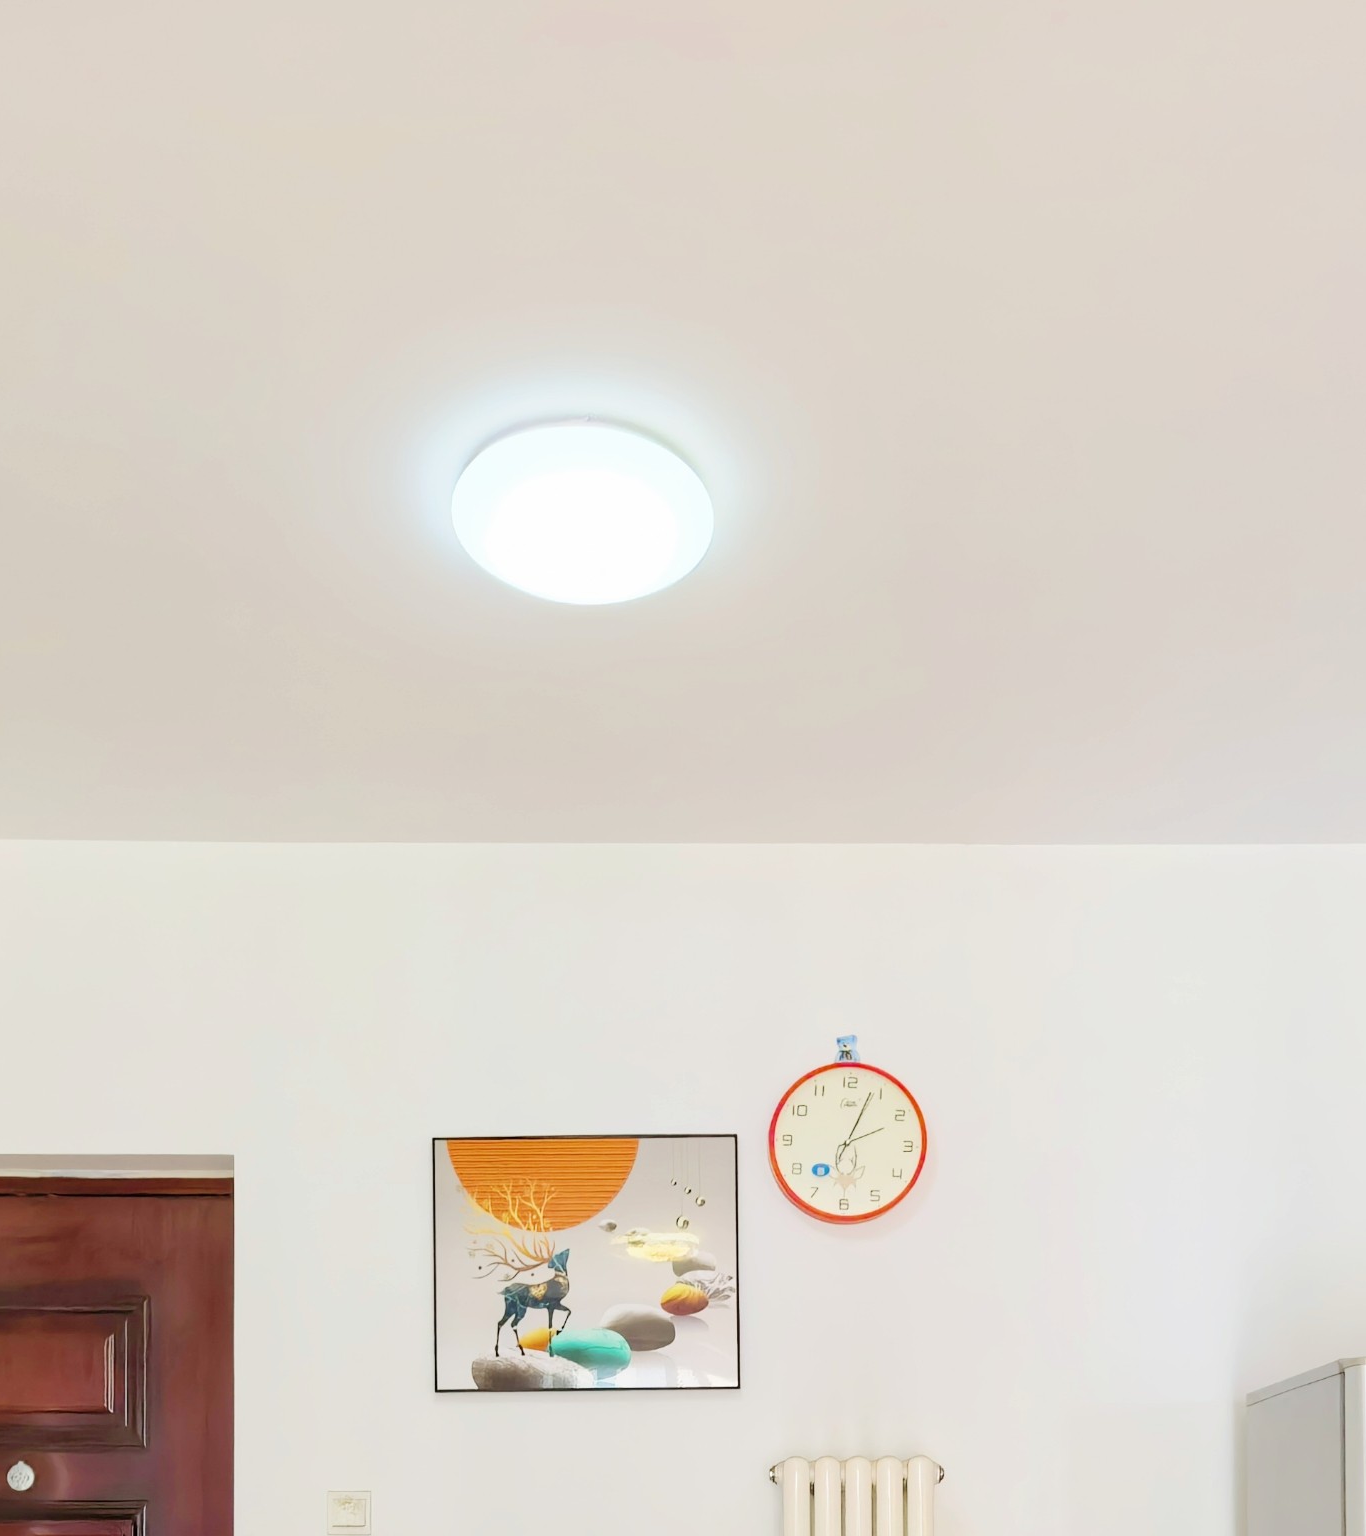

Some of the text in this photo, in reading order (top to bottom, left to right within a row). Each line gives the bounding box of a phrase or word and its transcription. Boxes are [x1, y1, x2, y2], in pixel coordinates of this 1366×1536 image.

[842, 1077, 858, 1088] 12
[814, 1085, 825, 1096] 11
[792, 1105, 807, 1116] 10
[895, 1110, 905, 1121] 2
[782, 1135, 792, 1146] 9
[903, 1141, 913, 1152] 3
[792, 1163, 802, 1175] 8
[892, 1169, 902, 1179] 4
[810, 1187, 819, 1198] 7
[870, 1190, 880, 1202] 5
[839, 1199, 849, 1210] 6
